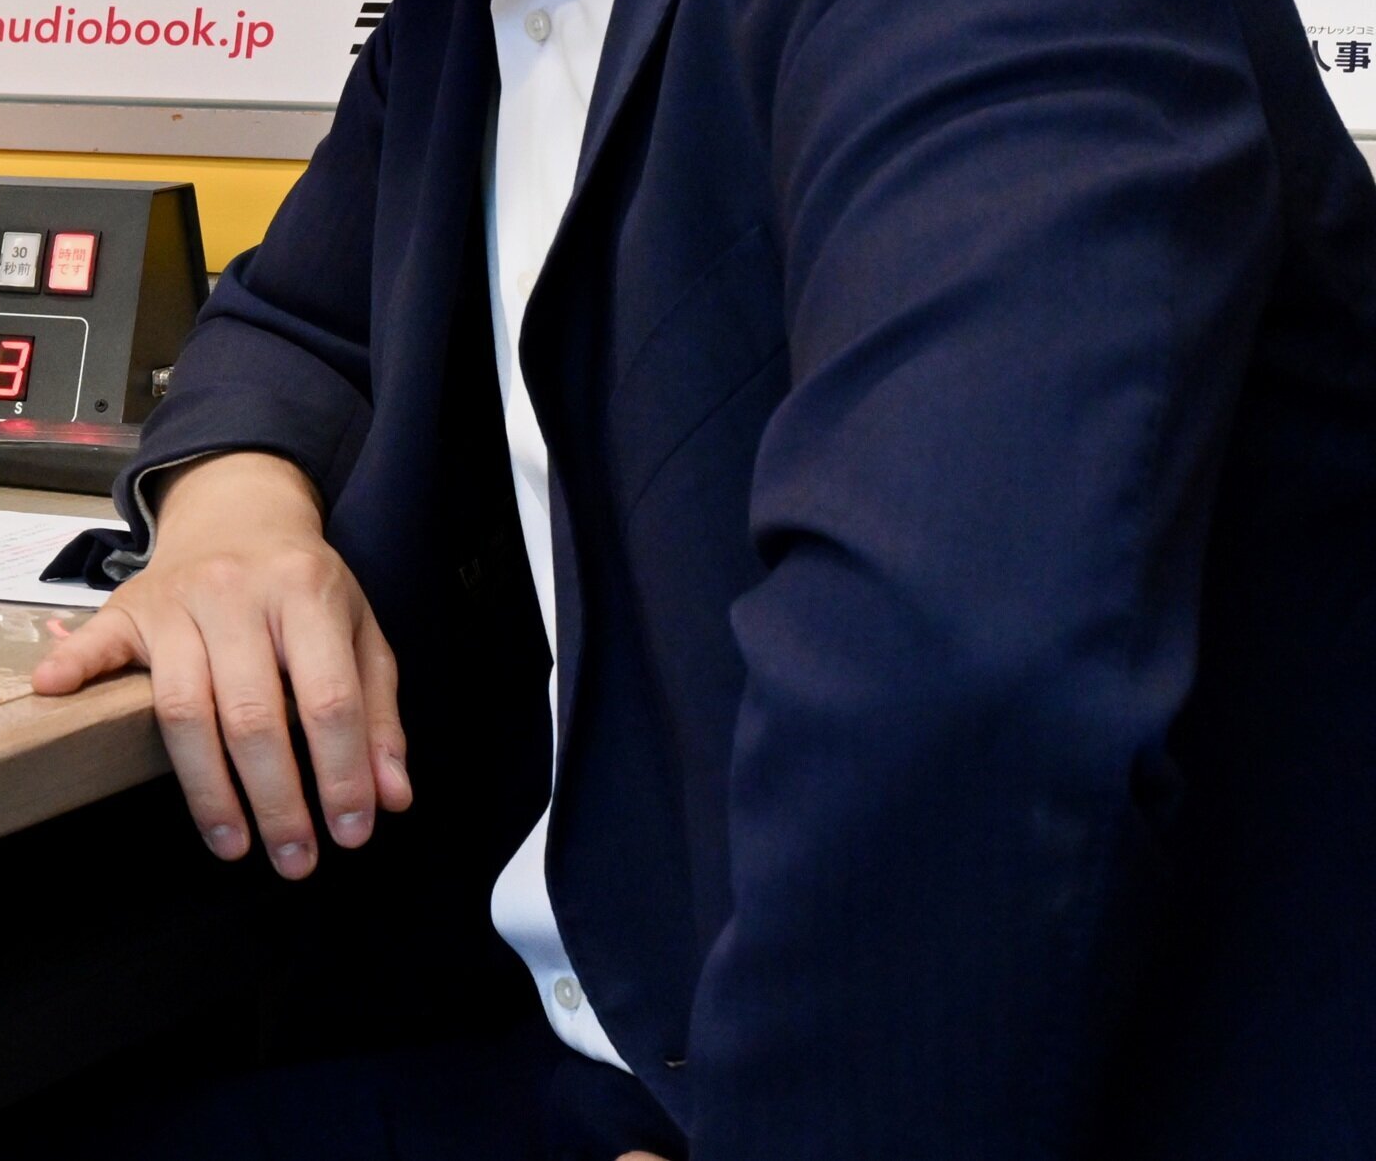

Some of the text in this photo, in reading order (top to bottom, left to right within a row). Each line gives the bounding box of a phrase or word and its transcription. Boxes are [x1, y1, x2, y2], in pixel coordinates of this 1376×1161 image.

[11, 246, 28, 259] 30
[58, 247, 86, 263] 時間
[2, 261, 31, 277] 秒前
[59, 264, 83, 275] です
[14, 401, 23, 415] S
